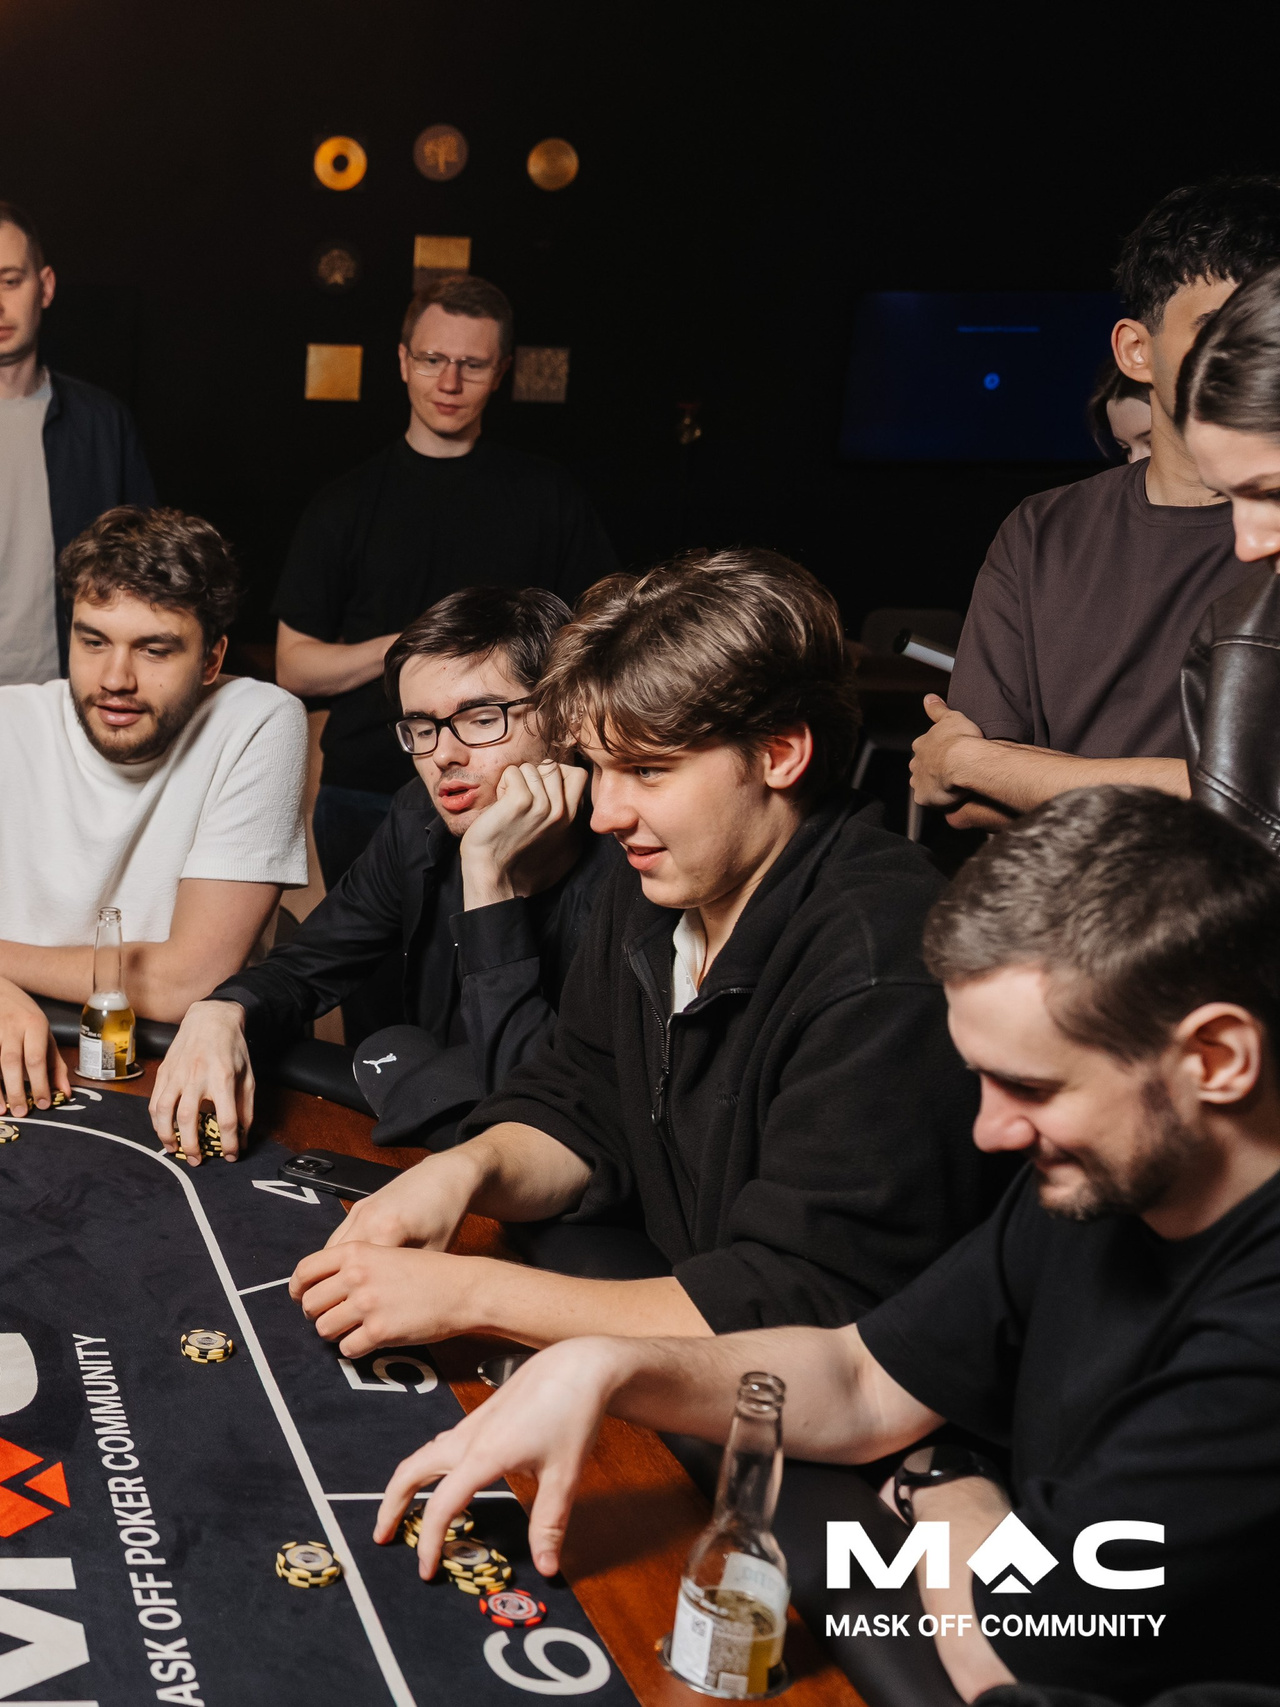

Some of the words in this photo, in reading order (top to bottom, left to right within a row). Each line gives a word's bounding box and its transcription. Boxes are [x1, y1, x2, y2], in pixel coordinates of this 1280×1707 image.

[72, 1333, 140, 1471] COMMUNITY
[337, 1355, 439, 1394] 5
[107, 1476, 167, 1565] POKER
[129, 1572, 182, 1631] OFF
[483, 1626, 611, 1696] 6
